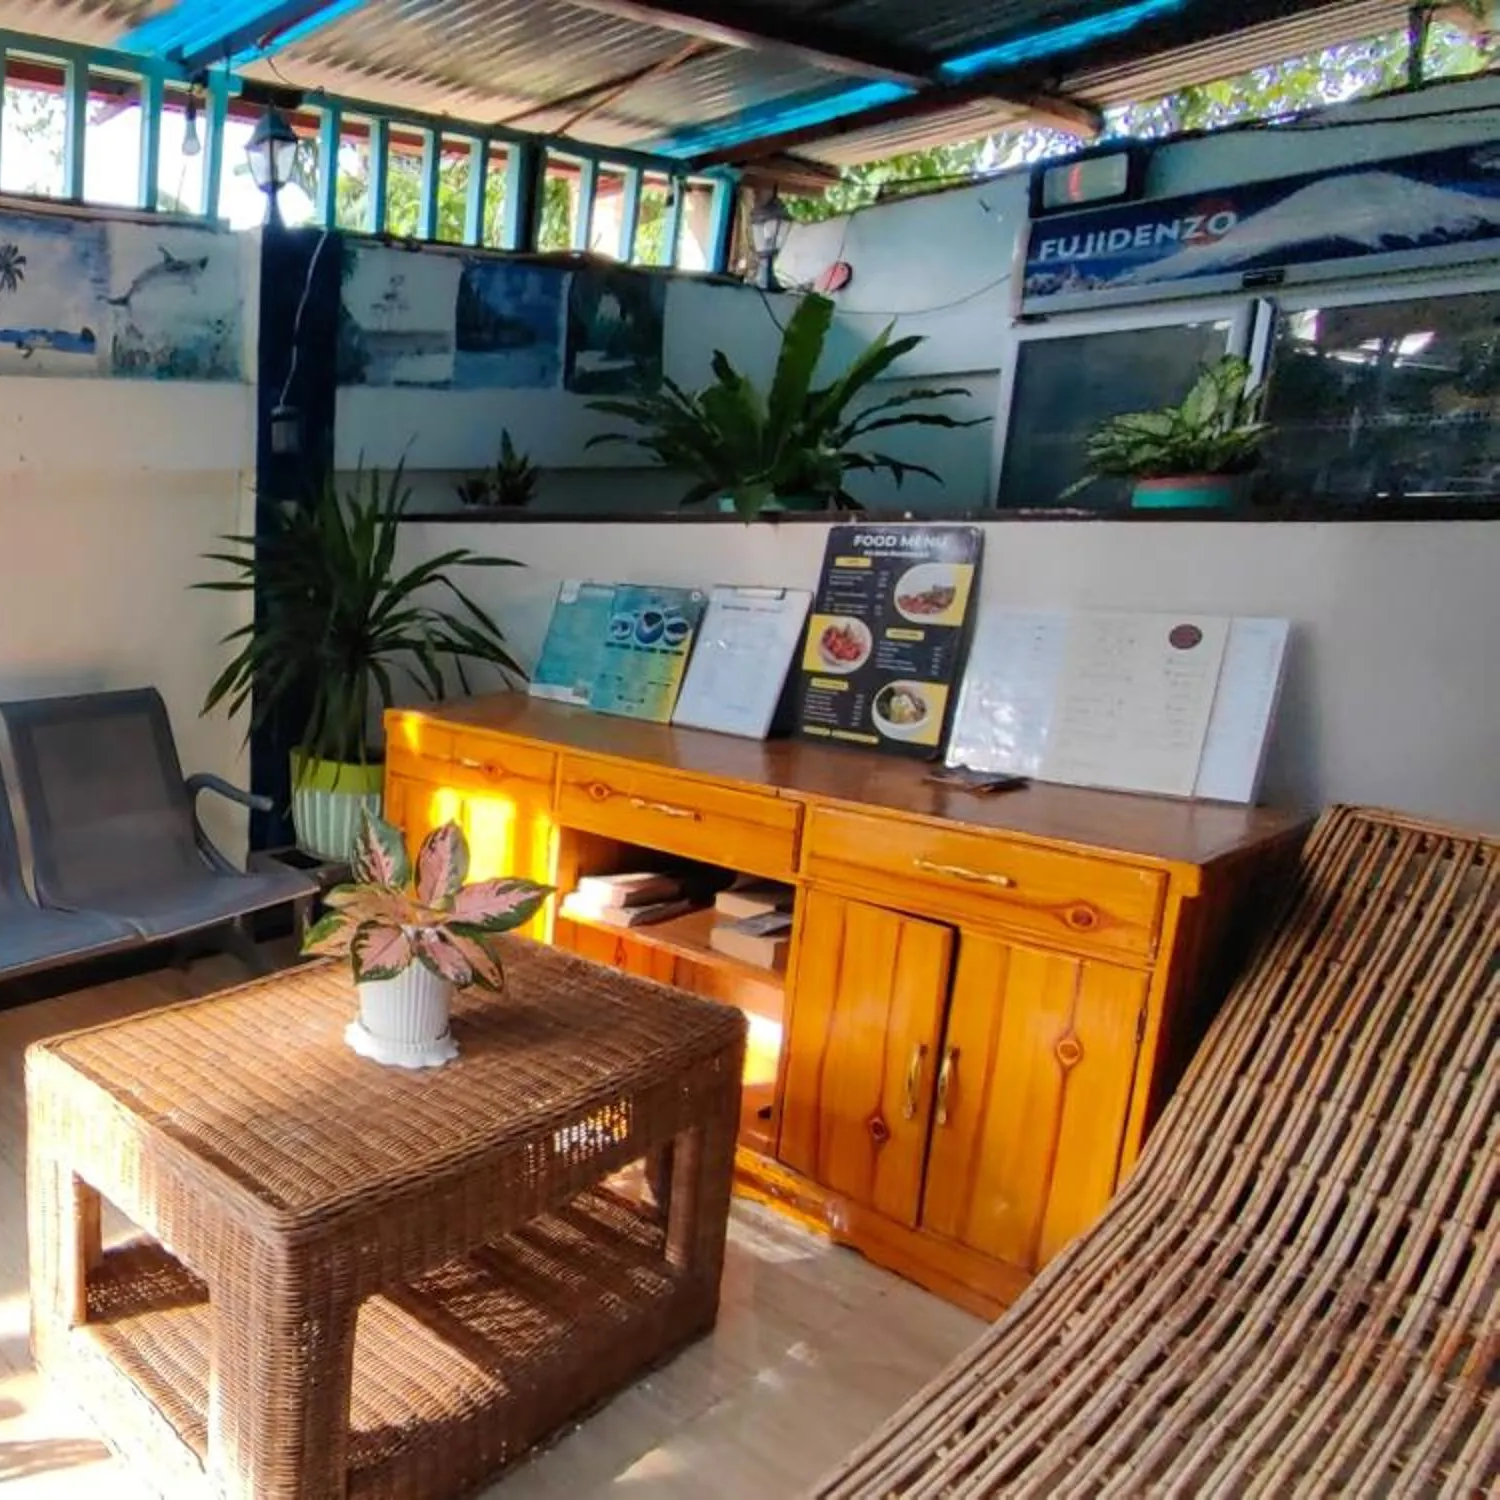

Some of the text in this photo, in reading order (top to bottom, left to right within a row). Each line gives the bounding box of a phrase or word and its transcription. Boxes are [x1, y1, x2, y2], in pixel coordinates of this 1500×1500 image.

[1039, 211, 1237, 262] FUJIDENZO
[852, 534, 949, 548] FOOD MENU
